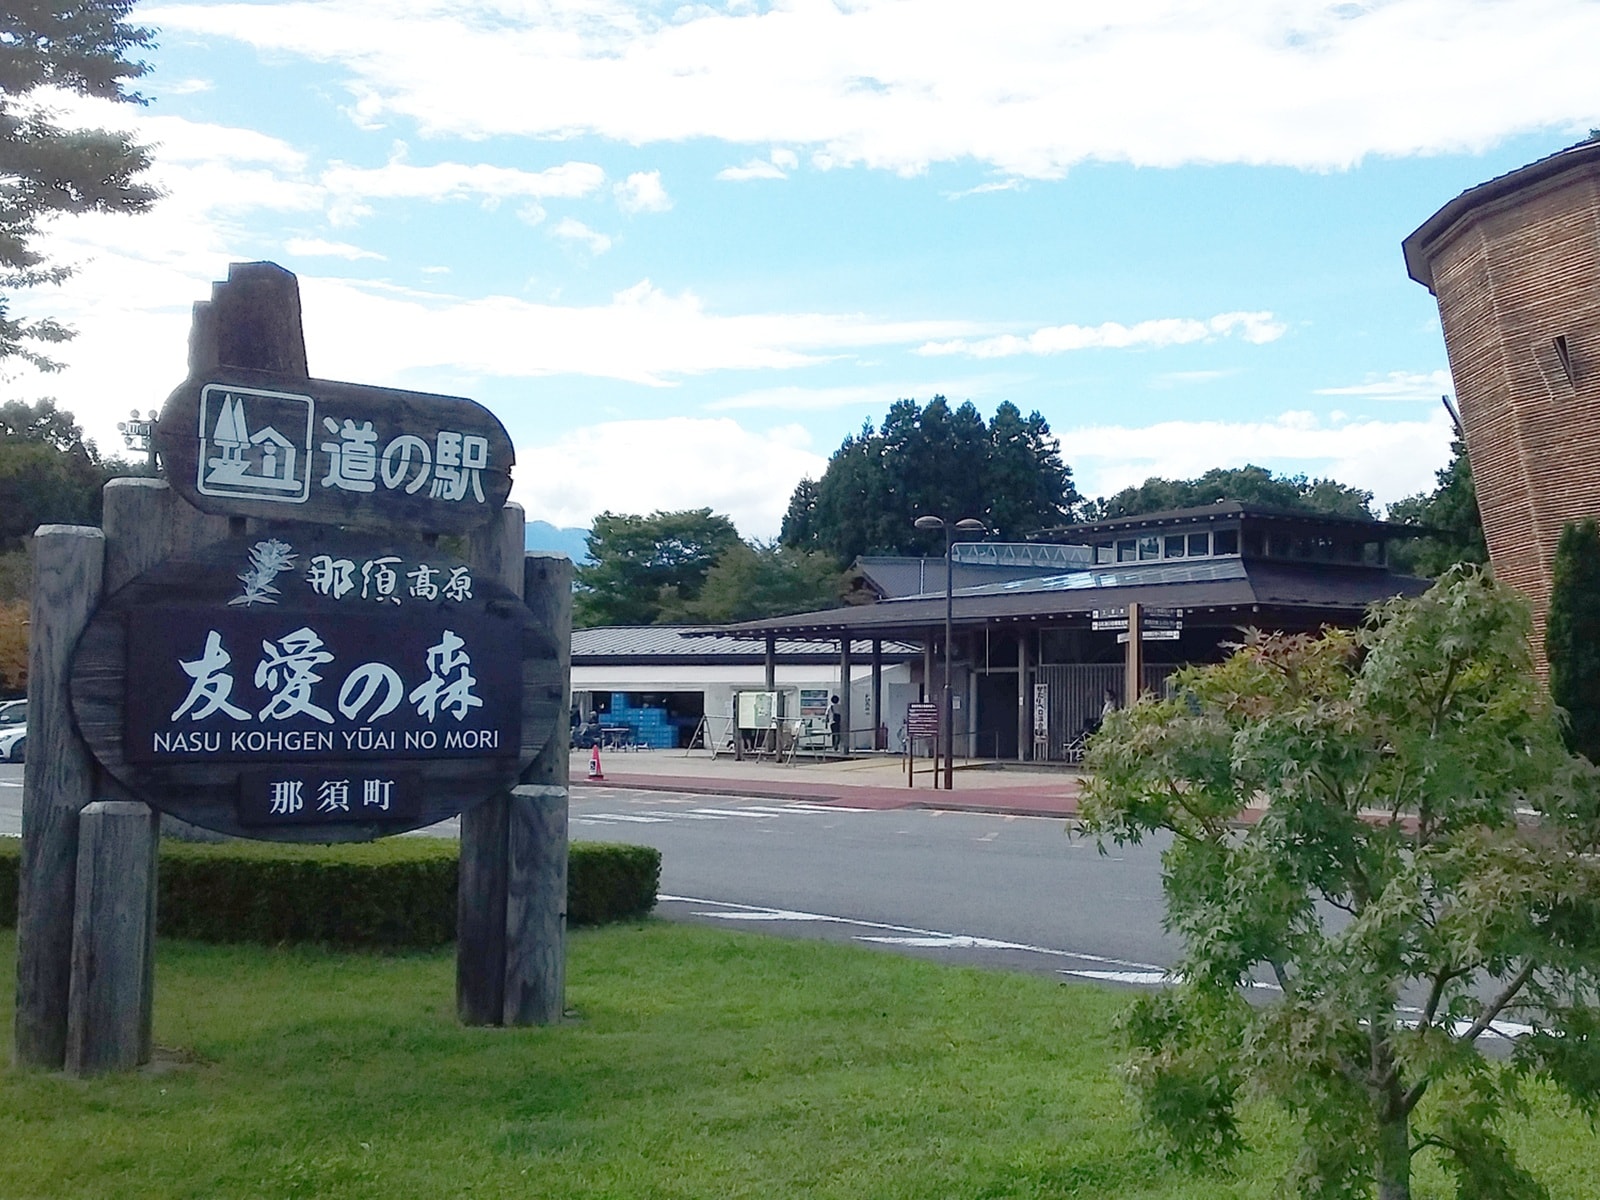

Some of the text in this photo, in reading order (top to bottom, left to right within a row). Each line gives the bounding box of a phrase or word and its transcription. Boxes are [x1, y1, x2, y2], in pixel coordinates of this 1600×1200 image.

[320, 416, 489, 503] 道の駅
[306, 555, 473, 607] 那須高原
[171, 626, 484, 724] 友愛の森
[153, 726, 499, 752] NASU KOHGEN YŪAI NO MORI
[270, 779, 395, 815] 那須町
